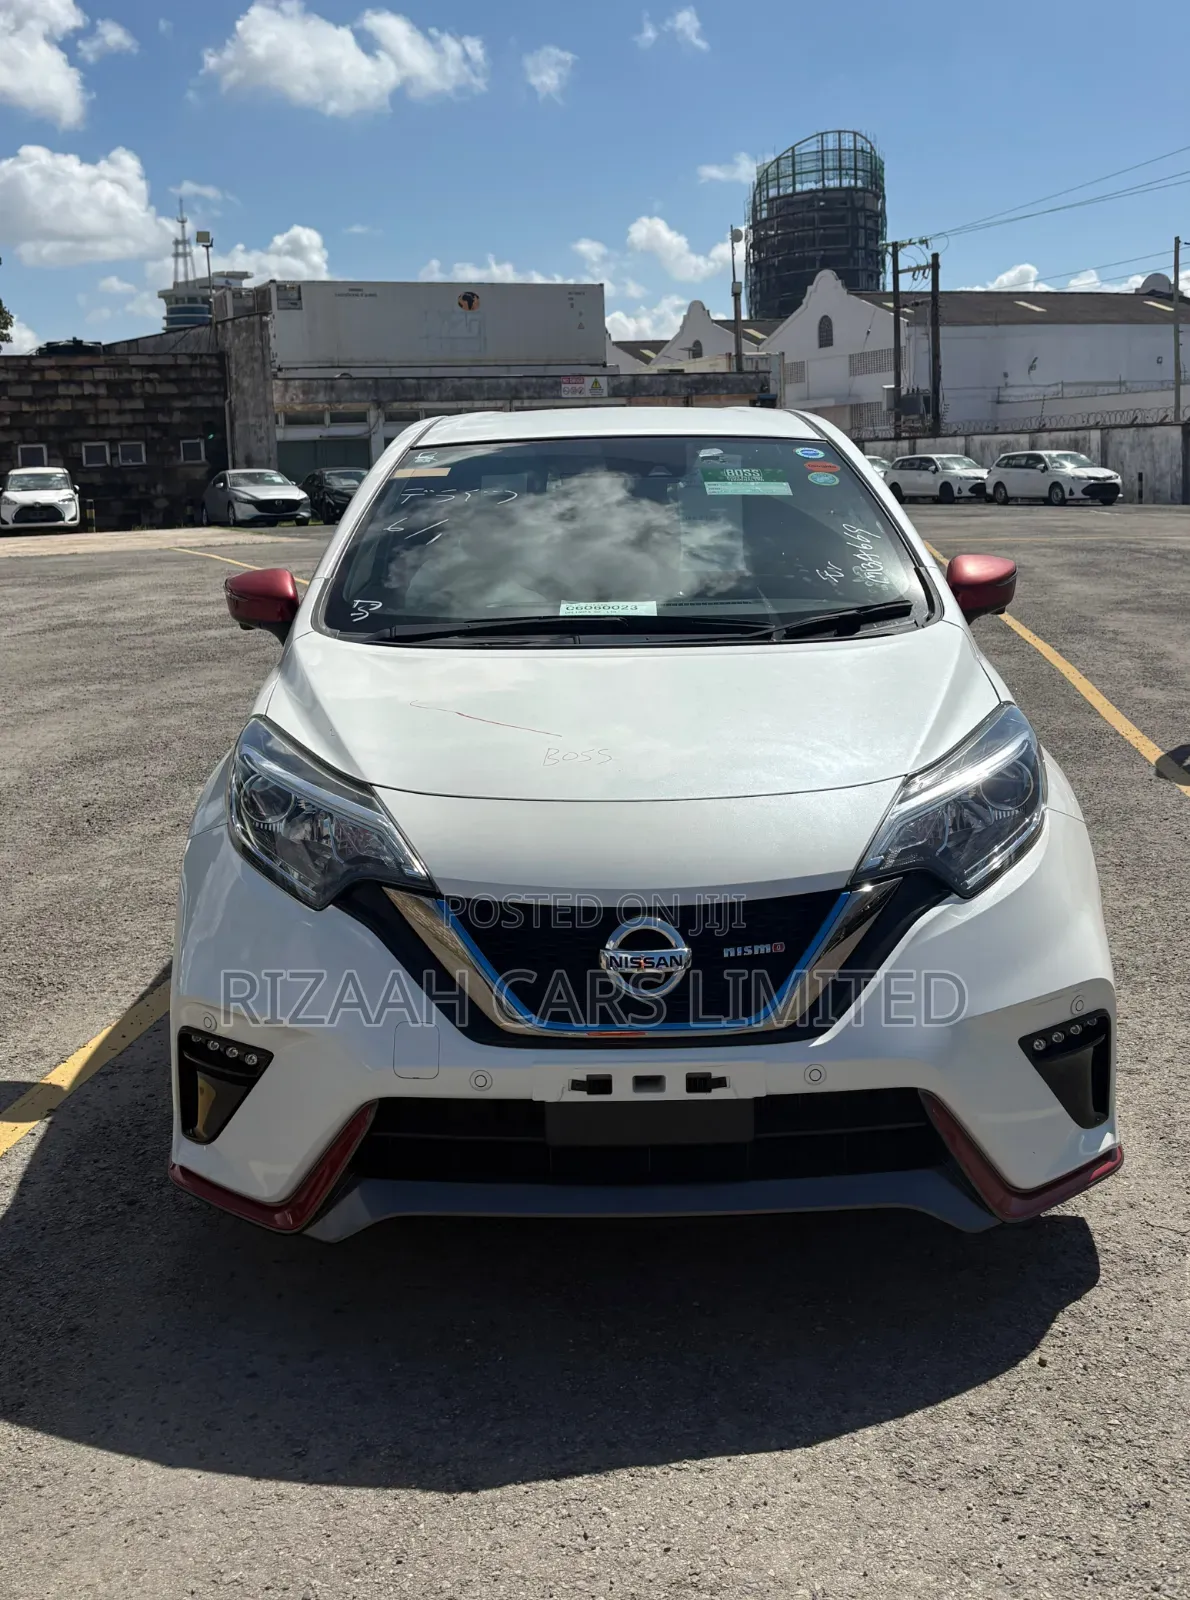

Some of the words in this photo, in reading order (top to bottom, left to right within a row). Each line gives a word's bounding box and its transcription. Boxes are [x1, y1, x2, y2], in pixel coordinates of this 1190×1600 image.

[726, 469, 761, 477] BOSS
[543, 747, 613, 766] BOSS
[609, 954, 683, 969] NISSAN
